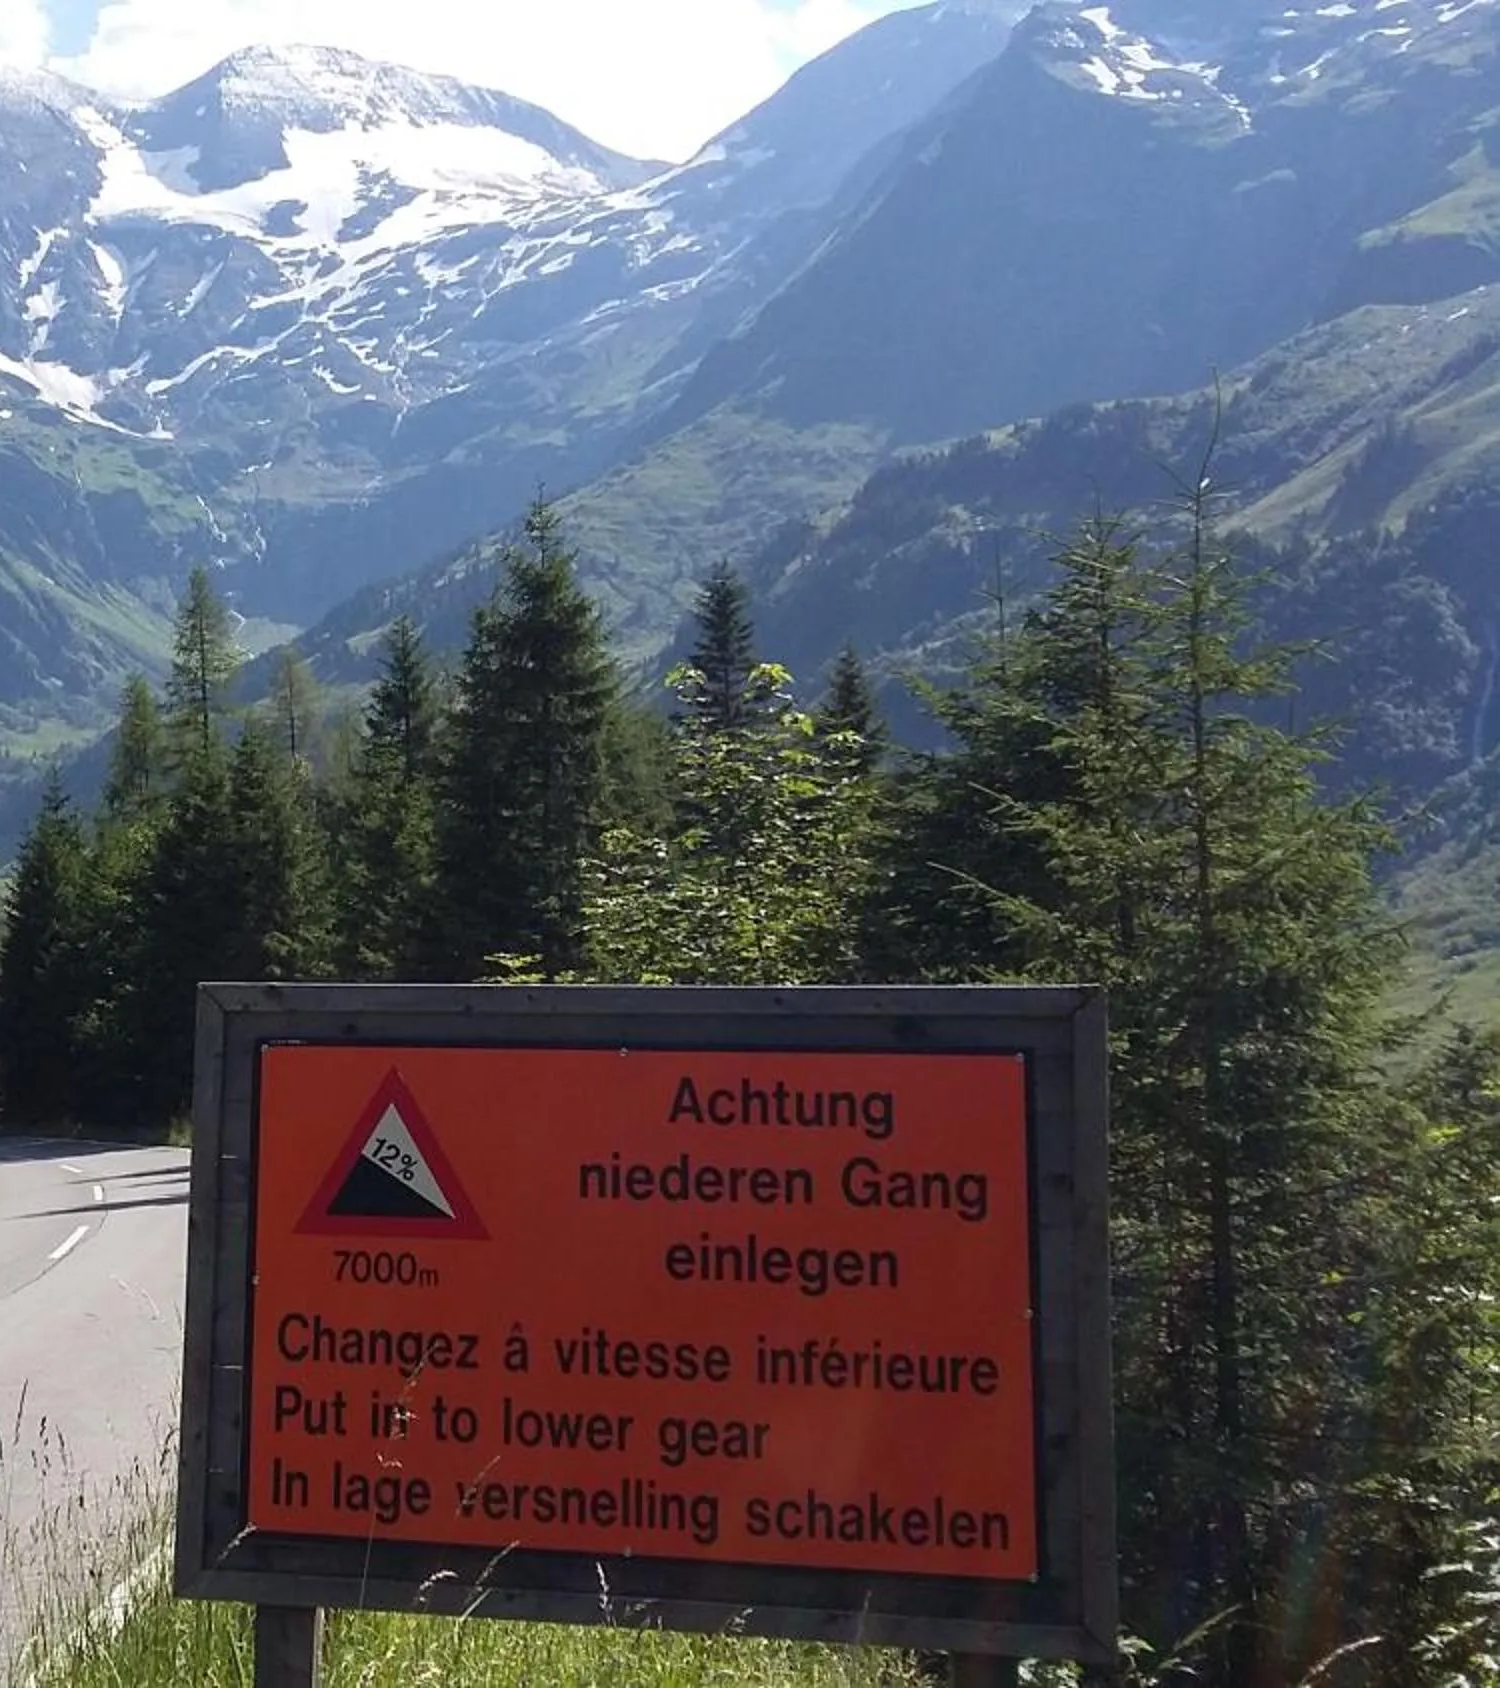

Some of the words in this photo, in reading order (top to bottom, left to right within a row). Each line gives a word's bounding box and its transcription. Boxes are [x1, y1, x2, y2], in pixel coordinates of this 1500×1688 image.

[668, 1076, 896, 1138] Achtung
[371, 1137, 419, 1182] 12%
[579, 1152, 816, 1204] niederen
[840, 1157, 990, 1222] Gang
[665, 1233, 900, 1296] einlegen
[276, 1313, 480, 1377] Changez
[553, 1327, 732, 1383] vitesse
[757, 1334, 1000, 1396] inférieure
[274, 1385, 348, 1436] Put
[369, 1390, 409, 1440] in
[432, 1396, 479, 1443] to
[503, 1397, 633, 1452] lower
[658, 1417, 770, 1466] gear
[271, 1457, 309, 1507] In
[332, 1460, 432, 1524] lage
[456, 1476, 721, 1543] versnelling
[745, 1489, 1011, 1552] schakelen
